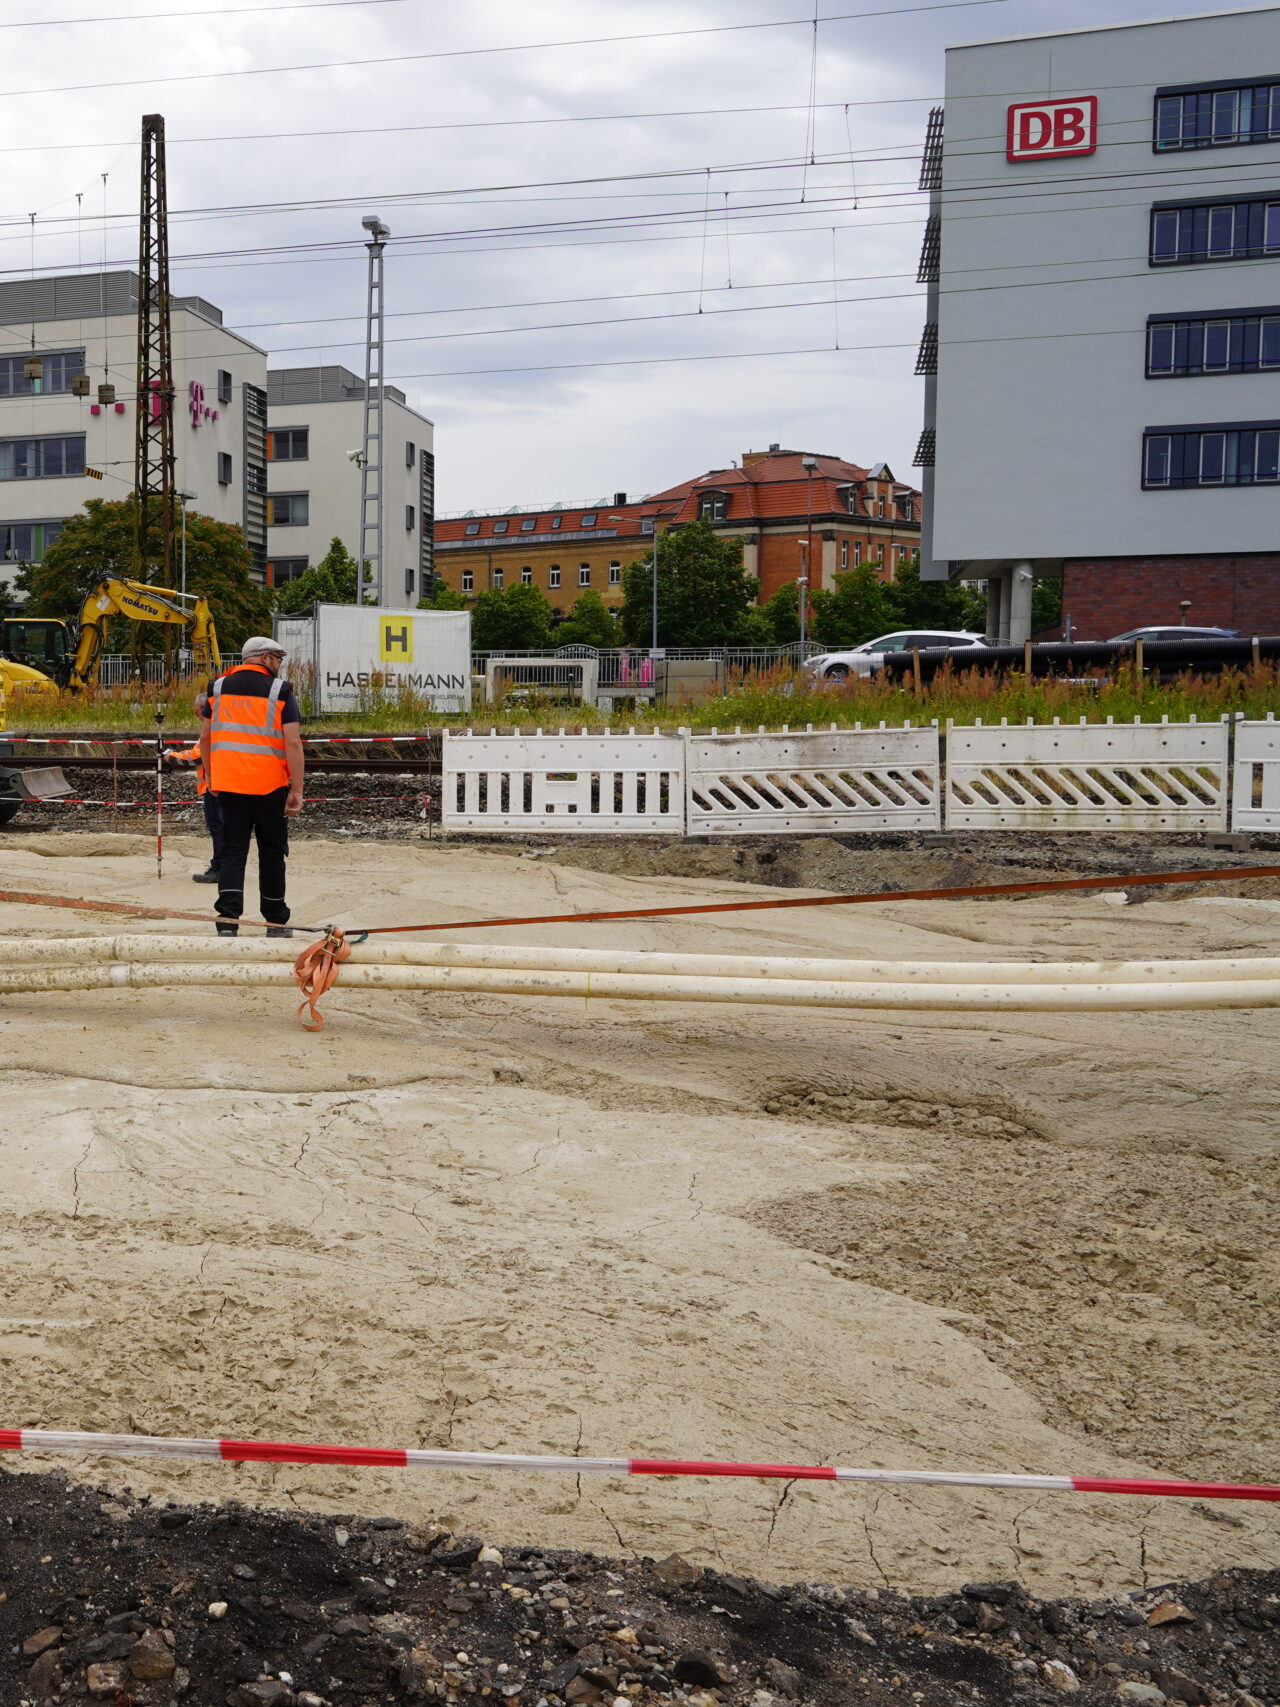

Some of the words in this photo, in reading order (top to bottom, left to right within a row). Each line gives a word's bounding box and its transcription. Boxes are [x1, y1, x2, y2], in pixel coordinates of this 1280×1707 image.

[1019, 107, 1085, 150] DB
[121, 596, 159, 615] KOMATSU
[385, 625, 408, 652] H
[326, 671, 465, 689] HASELMANN
